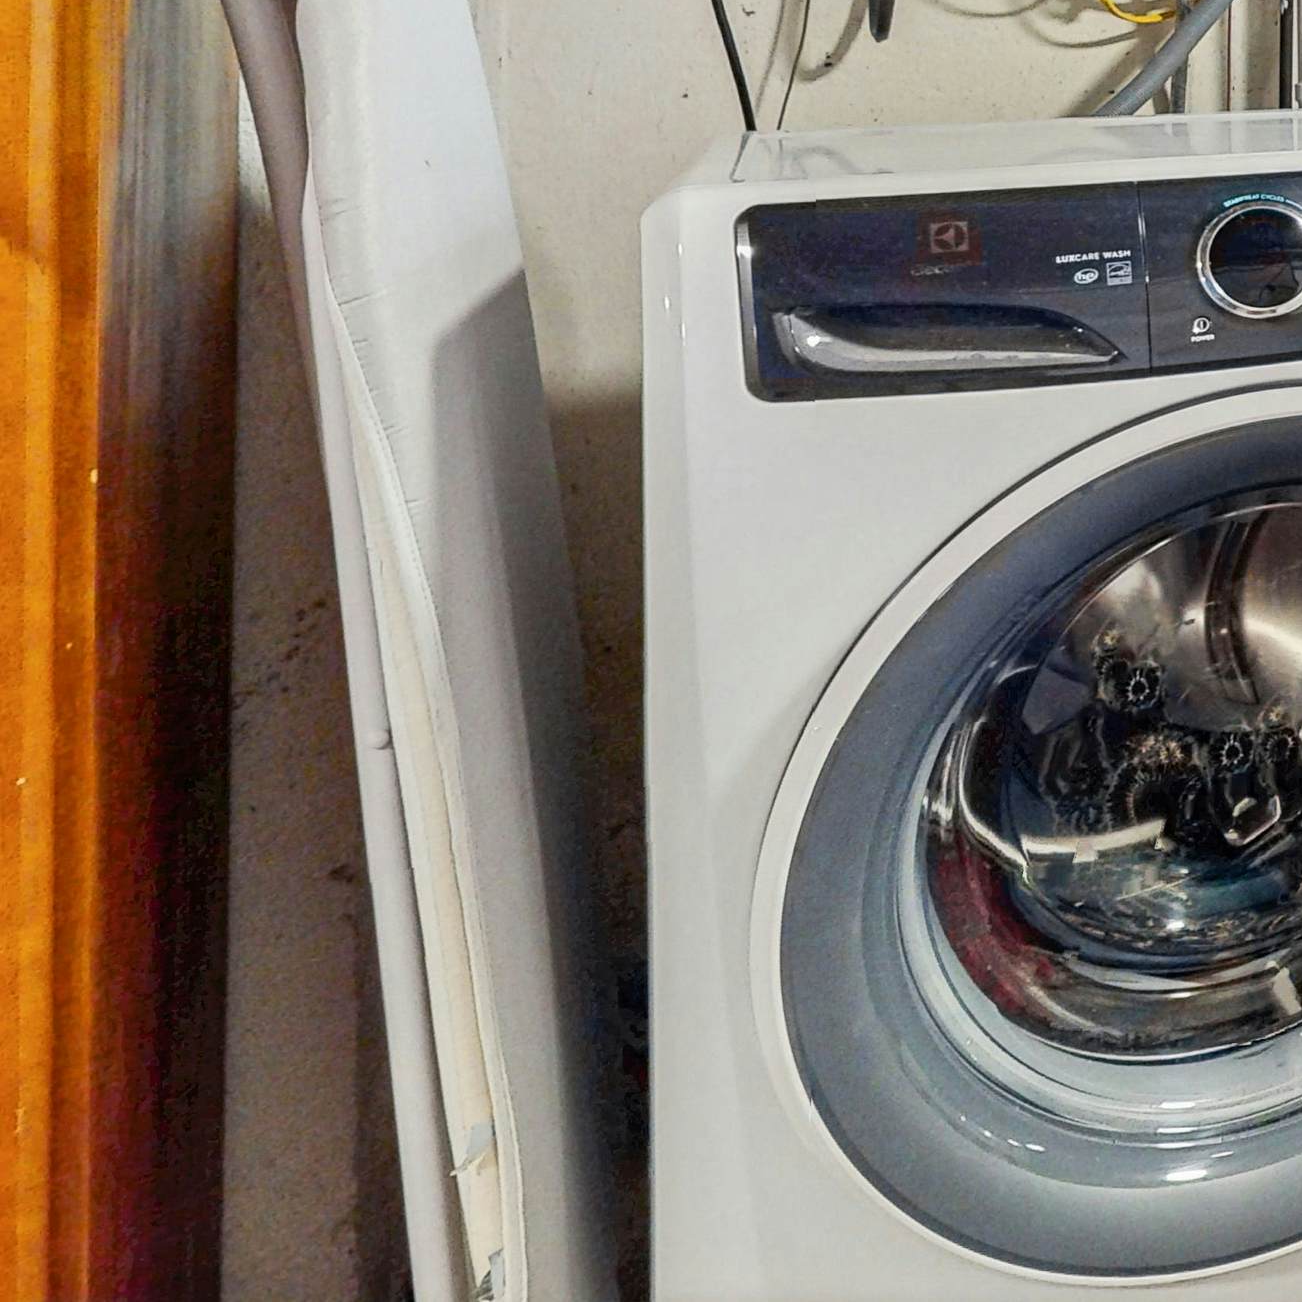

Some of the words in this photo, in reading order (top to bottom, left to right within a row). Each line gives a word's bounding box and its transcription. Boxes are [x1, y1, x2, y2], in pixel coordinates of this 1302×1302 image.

[1055, 251, 1100, 264] LUXCARE
[1102, 249, 1131, 260] WASH
[1190, 333, 1215, 343] POWER
